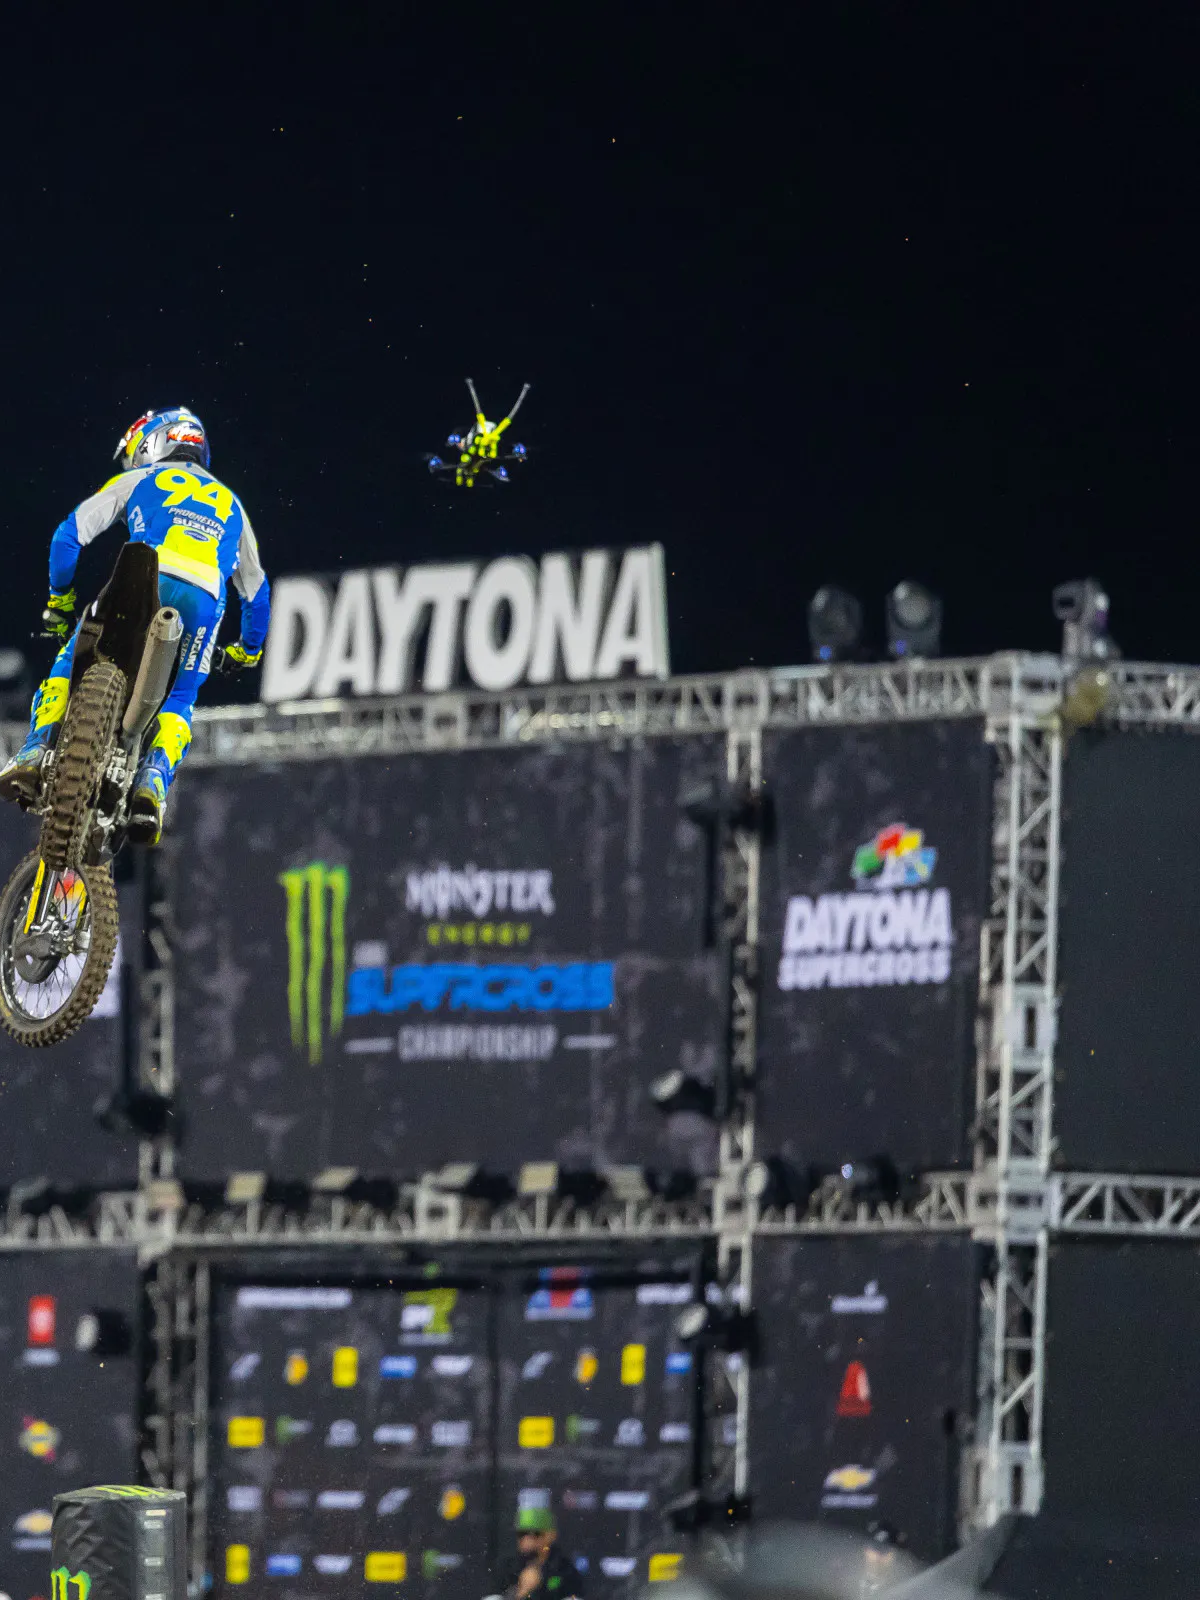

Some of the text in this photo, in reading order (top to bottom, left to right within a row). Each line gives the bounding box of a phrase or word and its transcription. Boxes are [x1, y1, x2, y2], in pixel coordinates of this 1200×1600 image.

[155, 468, 234, 524] 94
[172, 516, 222, 541] SUZUKI
[184, 626, 207, 671] SUZUKI
[258, 542, 670, 702] DAYTONA
[405, 862, 556, 918] MONSTER
[783, 887, 950, 952] DAYTONA
[347, 960, 617, 1016] SUPERCROSS
[777, 949, 950, 991] SUPERCROSS
